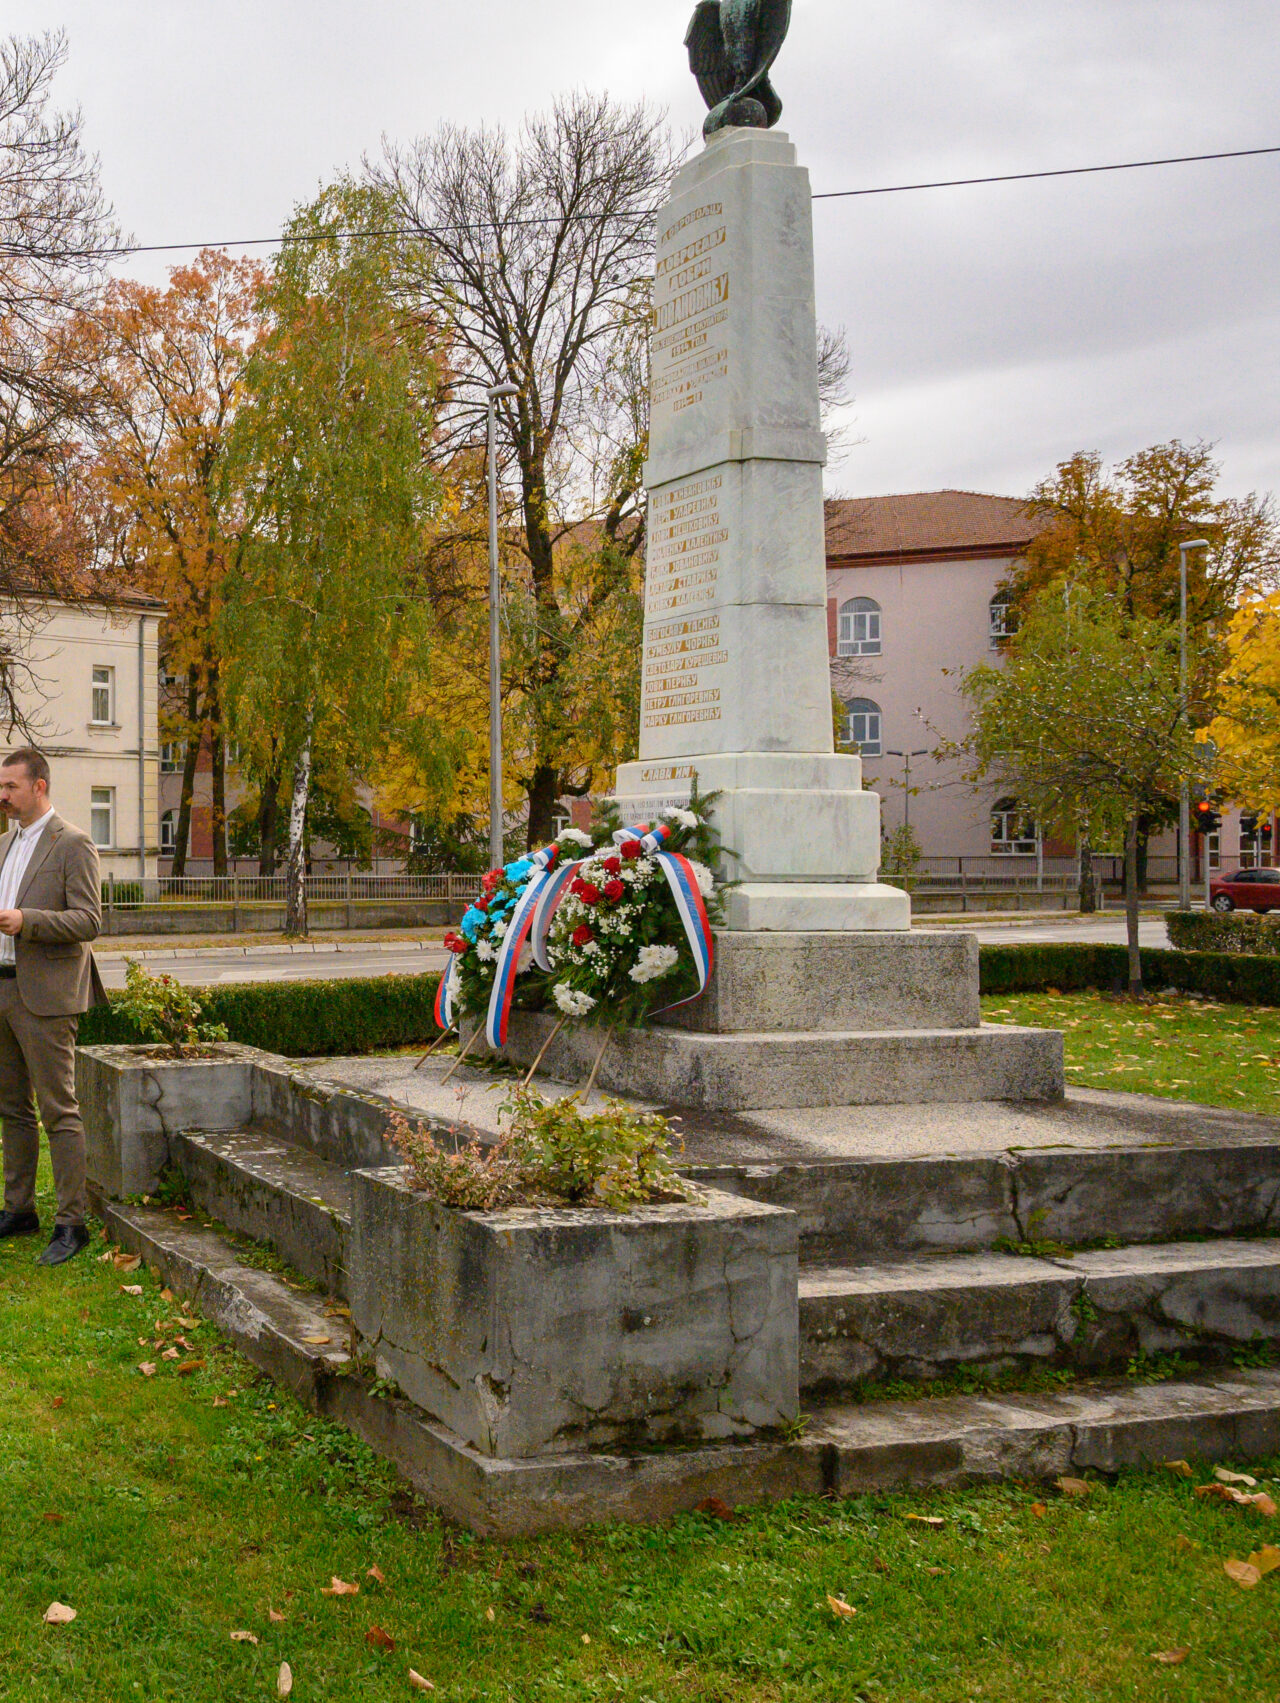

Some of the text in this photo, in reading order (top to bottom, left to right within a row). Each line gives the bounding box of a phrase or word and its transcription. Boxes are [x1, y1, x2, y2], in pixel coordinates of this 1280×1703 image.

[687, 615, 719, 634] ТАСИЋУ
[646, 658, 682, 676] СВЕТОЗАРУ
[646, 673, 697, 693] ЈОВИ ПЕРИЋУ
[645, 696, 667, 711] ПЕТРУ
[645, 714, 667, 728] МАРКУ
[641, 767, 672, 781] СЛАВА
